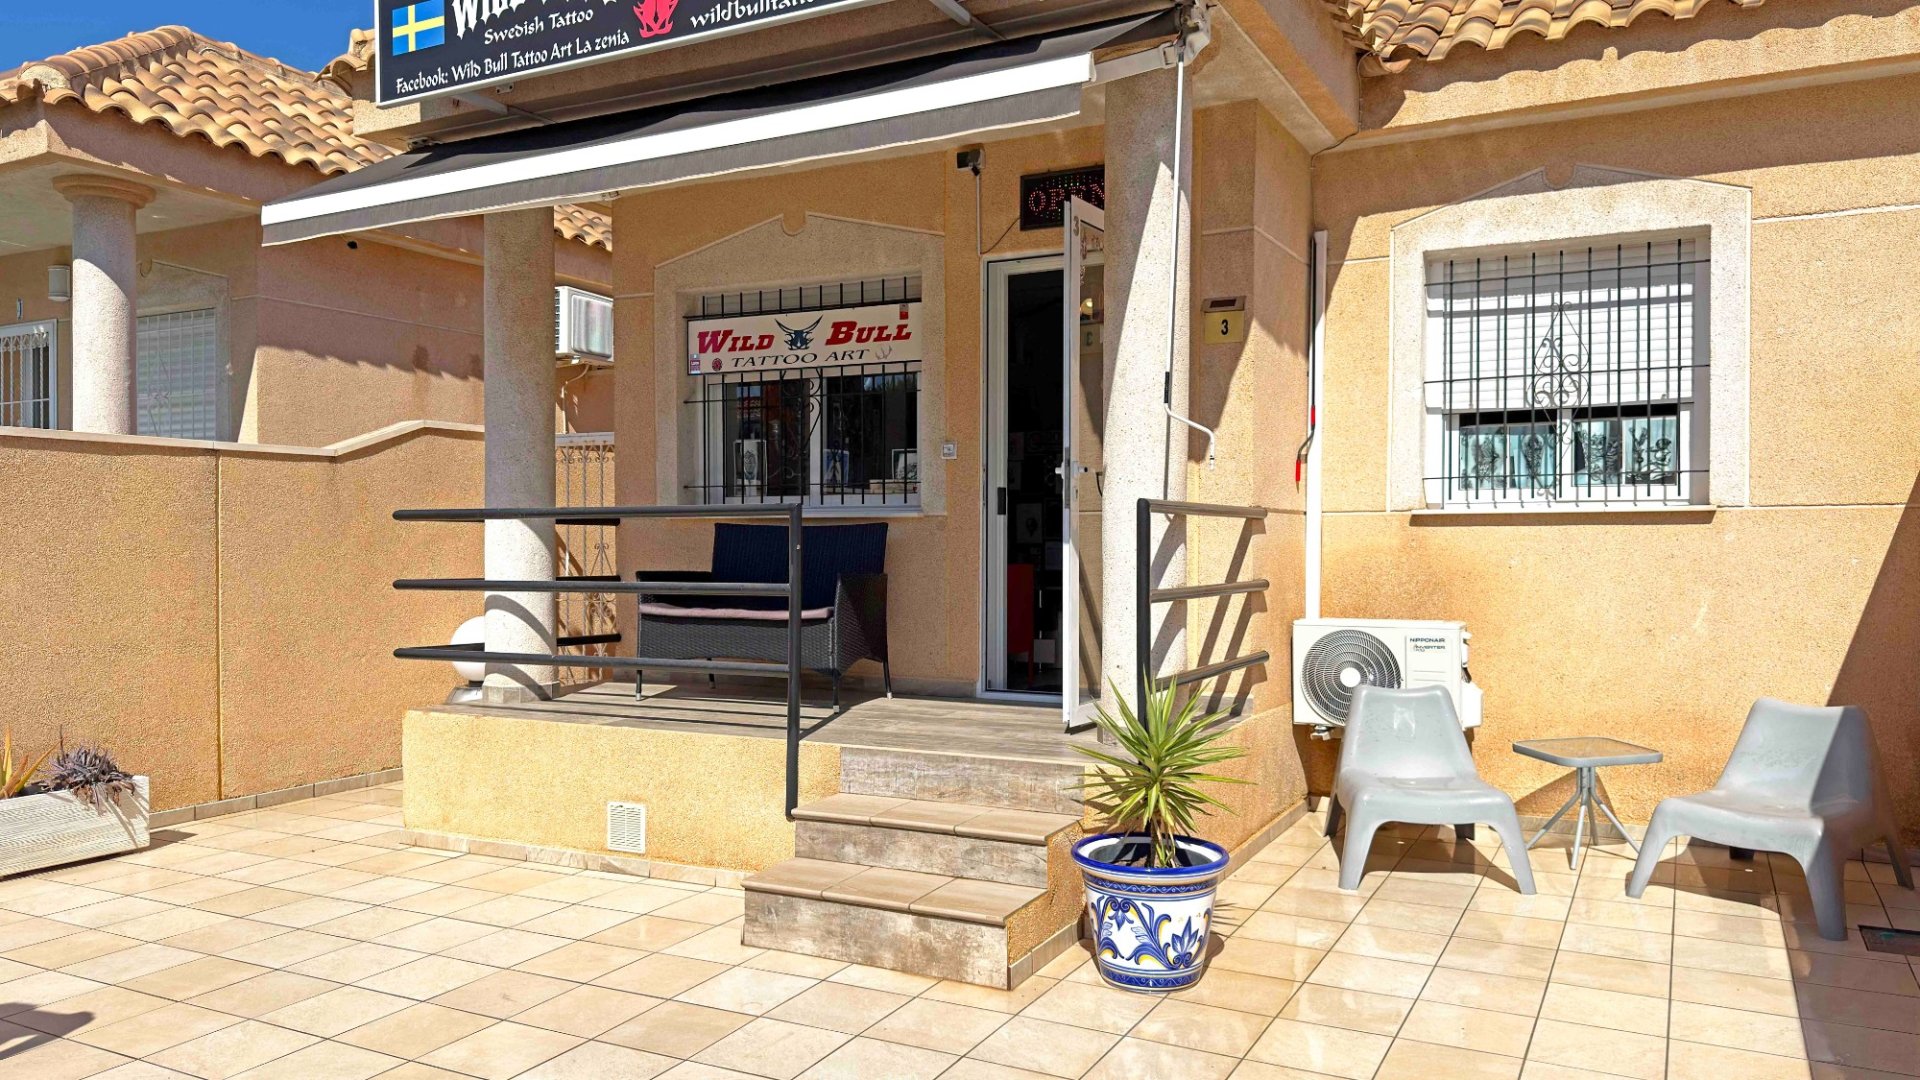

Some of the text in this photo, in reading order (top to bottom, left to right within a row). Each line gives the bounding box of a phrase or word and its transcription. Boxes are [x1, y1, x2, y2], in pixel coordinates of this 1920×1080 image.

[484, 9, 594, 45] Swedish Tattoo
[395, 29, 631, 95] Facebook: Wild Bull Tattoo Art La zenia
[697, 320, 912, 354] WILD BULL
[1220, 319, 1229, 335] 3
[731, 349, 870, 368] TATTOO ART
